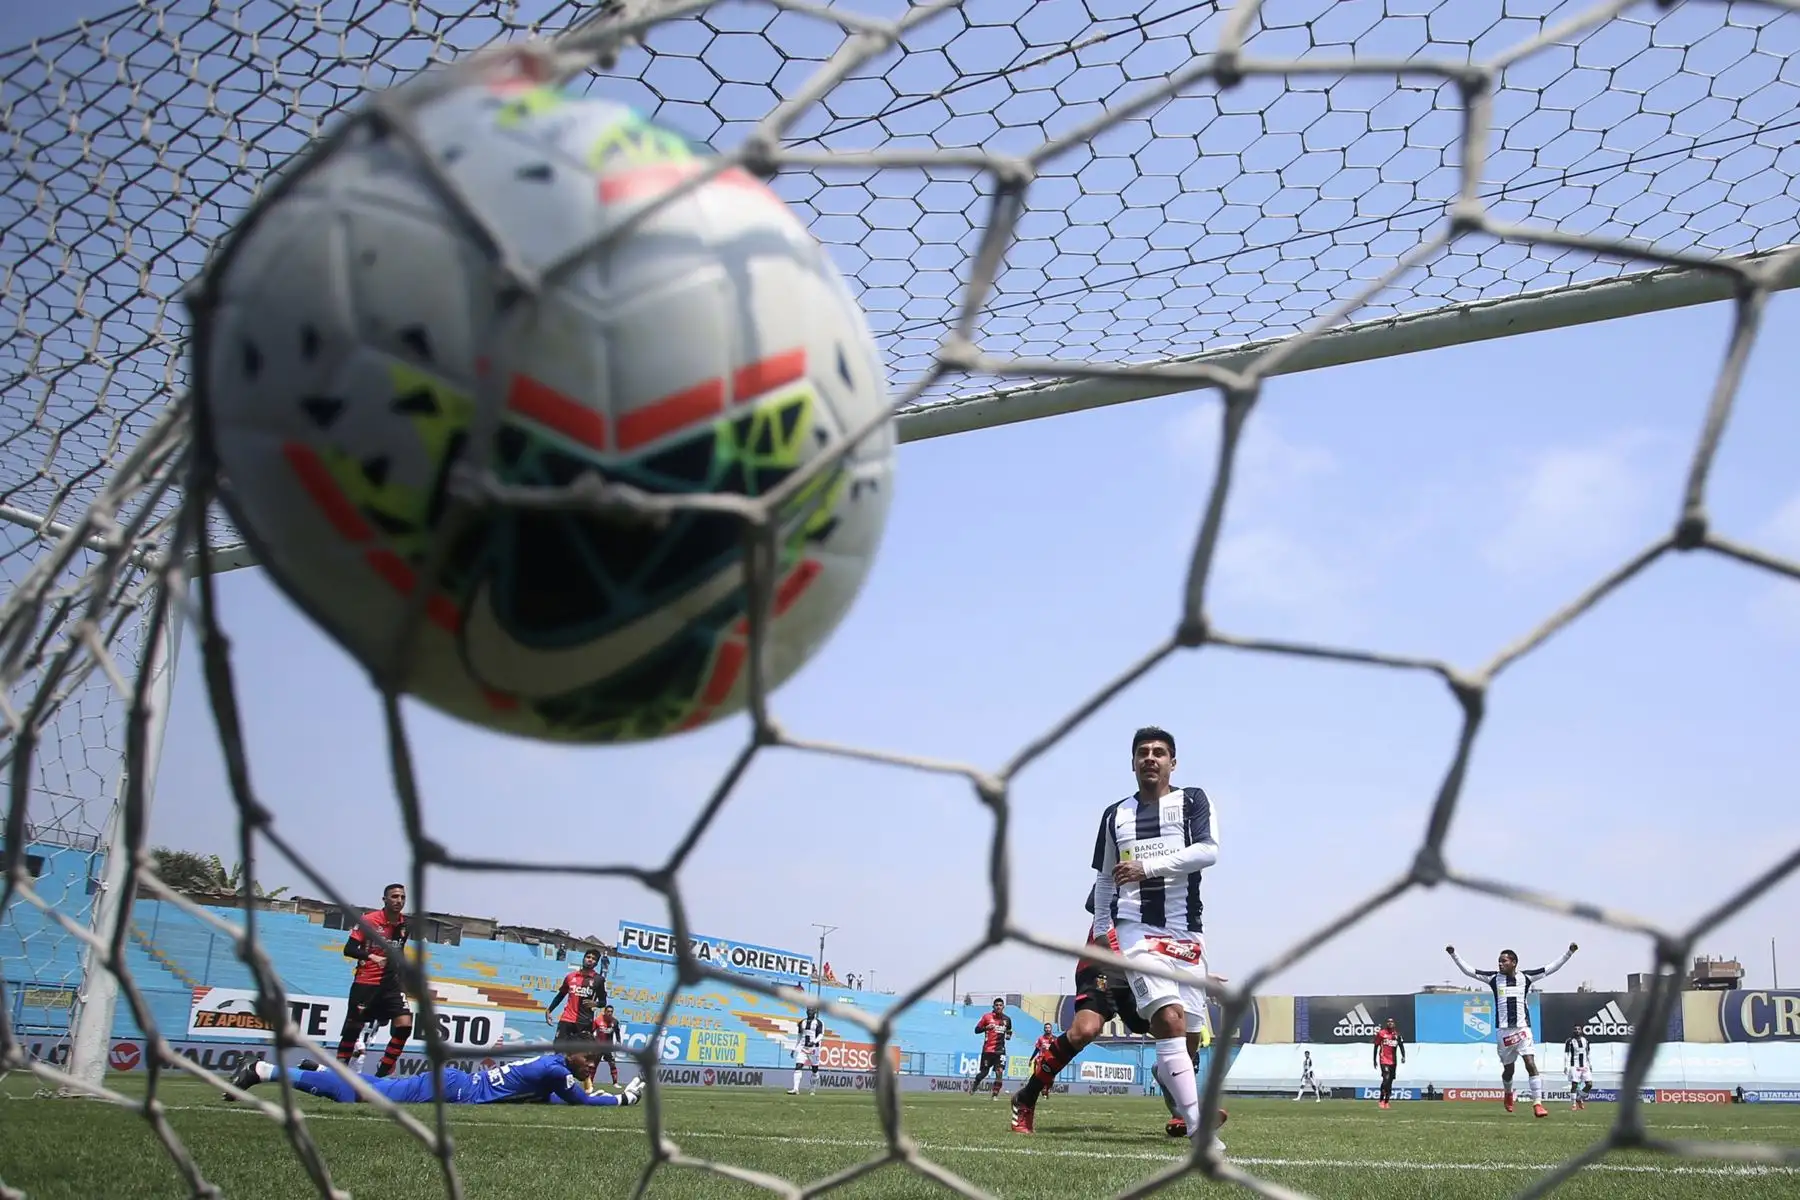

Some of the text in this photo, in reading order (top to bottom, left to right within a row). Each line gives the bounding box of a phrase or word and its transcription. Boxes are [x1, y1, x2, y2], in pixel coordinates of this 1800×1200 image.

[1135, 843, 1164, 853] BANCO
[731, 947, 809, 976] ORIENTE
[196, 1012, 212, 1026] TE
[1333, 1023, 1381, 1036] adidas
[1582, 1022, 1635, 1035] adidas
[697, 1032, 740, 1047] APUESTA
[699, 1047, 736, 1061] EN VIVO
[717, 1071, 763, 1085] WALON
[1095, 1065, 1103, 1078] TE
[1104, 1066, 1132, 1081] APUESTO
[820, 1075, 853, 1087] WALON
[937, 1080, 961, 1090] WALON
[1661, 1090, 1726, 1103] betsson
